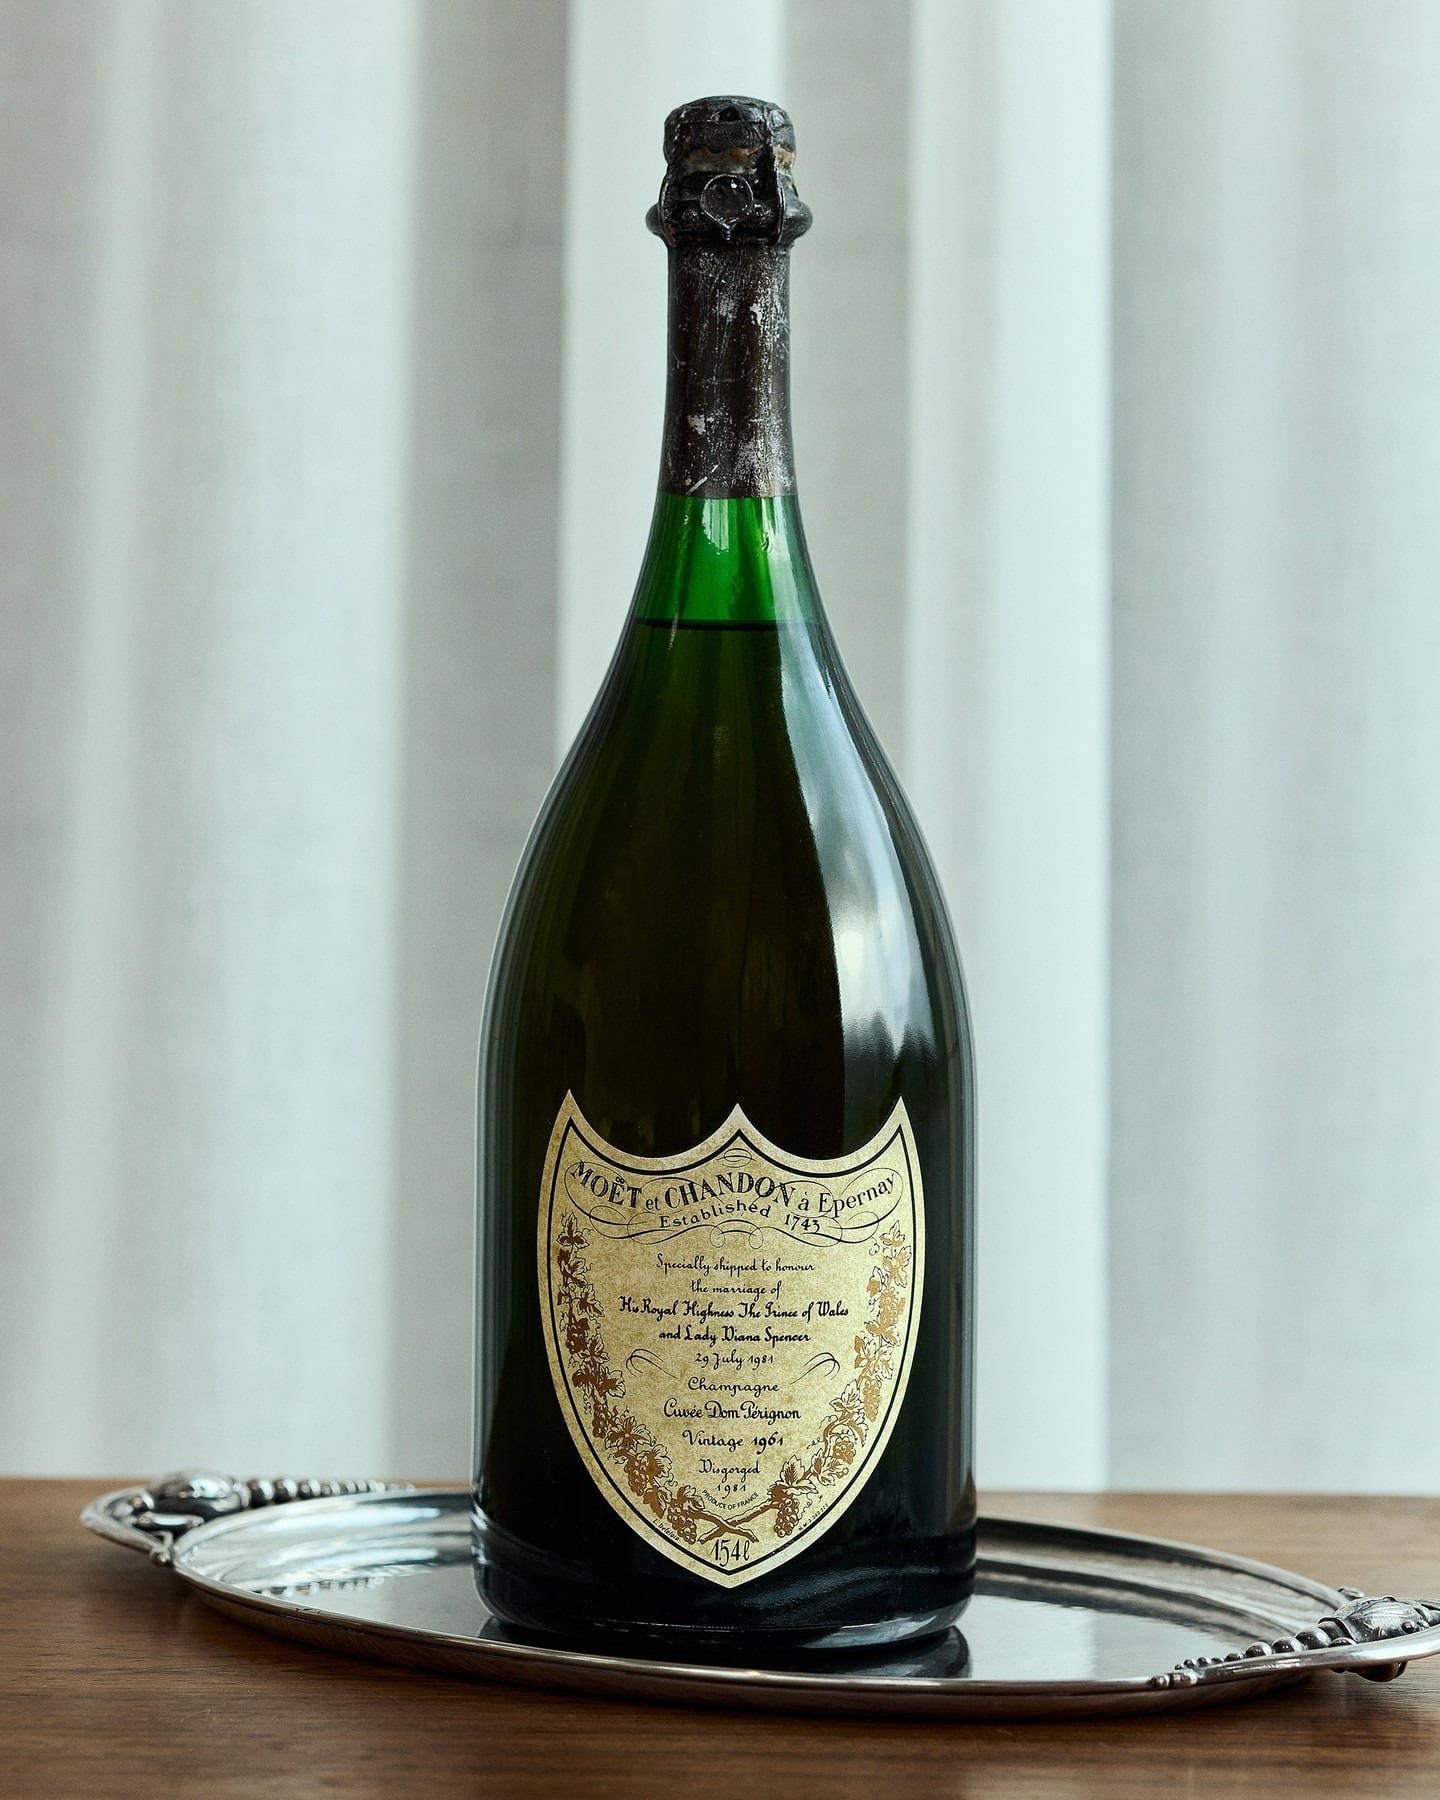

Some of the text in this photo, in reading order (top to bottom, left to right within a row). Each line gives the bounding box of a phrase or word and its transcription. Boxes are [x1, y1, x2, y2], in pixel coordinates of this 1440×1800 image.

[570, 1160, 642, 1209] MOËT
[645, 1195, 660, 1211] et
[664, 1171, 796, 1209] CHANDON
[819, 1173, 896, 1217] Epernay
[659, 1200, 820, 1233] Established 1743
[656, 1253, 815, 1277] Specially shipped to honour
[691, 1280, 782, 1302] the marriage of
[643, 1298, 676, 1321] Royal
[682, 1300, 734, 1324] Highness
[738, 1302, 761, 1318] The
[765, 1303, 798, 1318] Prince
[802, 1301, 813, 1322] of
[816, 1301, 848, 1317] Wales
[659, 1324, 811, 1348] and Lady Diana Spencer
[695, 1349, 773, 1369] 29 July 1981
[688, 1377, 779, 1398] Champagne
[664, 1398, 801, 1425] Cuvée Dom Pérignon
[682, 1430, 783, 1455] Vintage 1961
[698, 1459, 760, 1482] Disgorged
[702, 1490, 726, 1509] PRODUCE
[737, 1492, 759, 1508] FRANCE
[715, 1484, 746, 1499] 1981
